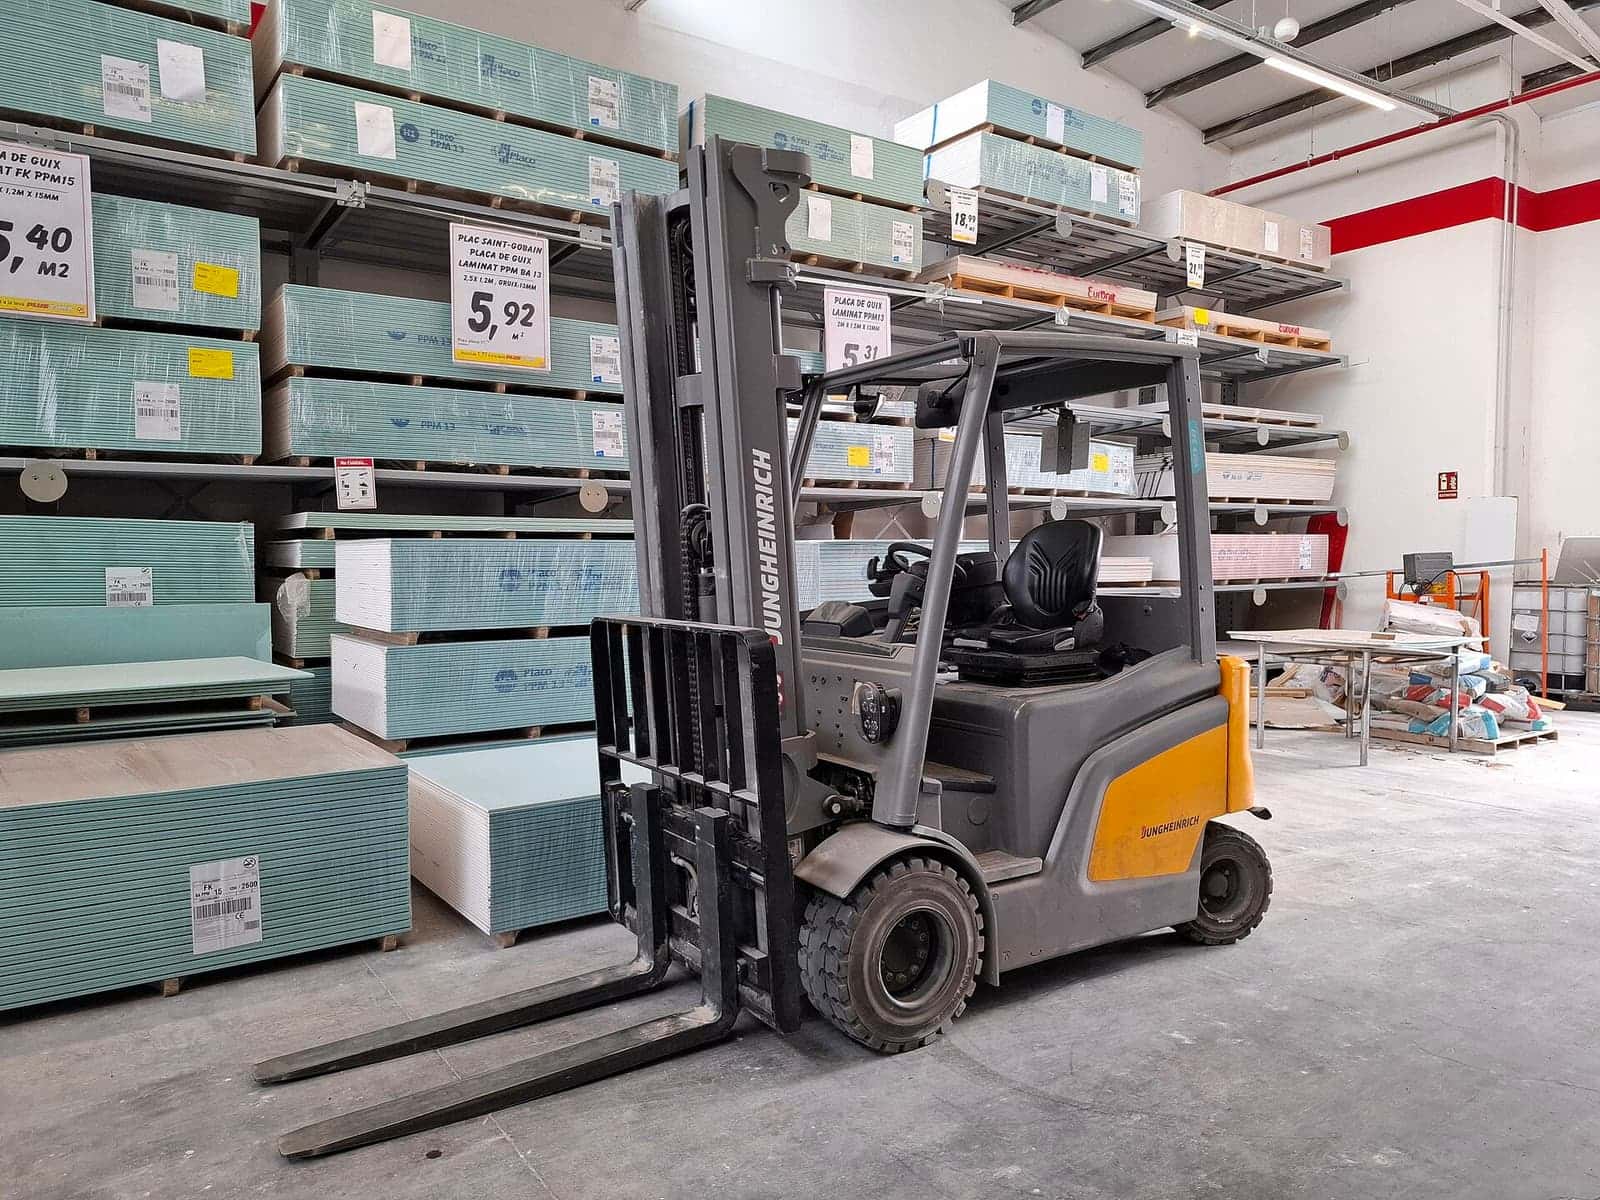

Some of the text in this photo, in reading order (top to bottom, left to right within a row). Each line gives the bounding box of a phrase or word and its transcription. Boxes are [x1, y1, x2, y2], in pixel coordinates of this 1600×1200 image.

[430, 128, 455, 142] Placo
[11, 152, 27, 164] DE
[30, 156, 61, 170] GUIX
[15, 168, 31, 180] FK
[34, 170, 75, 187] PPM15
[27, 190, 32, 198] X
[34, 191, 60, 202] 15MM
[457, 233, 543, 255] PLAC SAINT-GOBAIN
[498, 252, 510, 261] DE
[511, 254, 532, 265] GUIX
[38, 261, 70, 278] M2
[458, 259, 543, 279] LAMINAT PPM BA 13
[856, 299, 866, 308] DE
[866, 300, 883, 310] GUIX
[832, 307, 885, 322] LAMINAT PPM13
[752, 448, 783, 646] JUNGHEINRICH
[1141, 815, 1200, 840] JUNGHEINRICH
